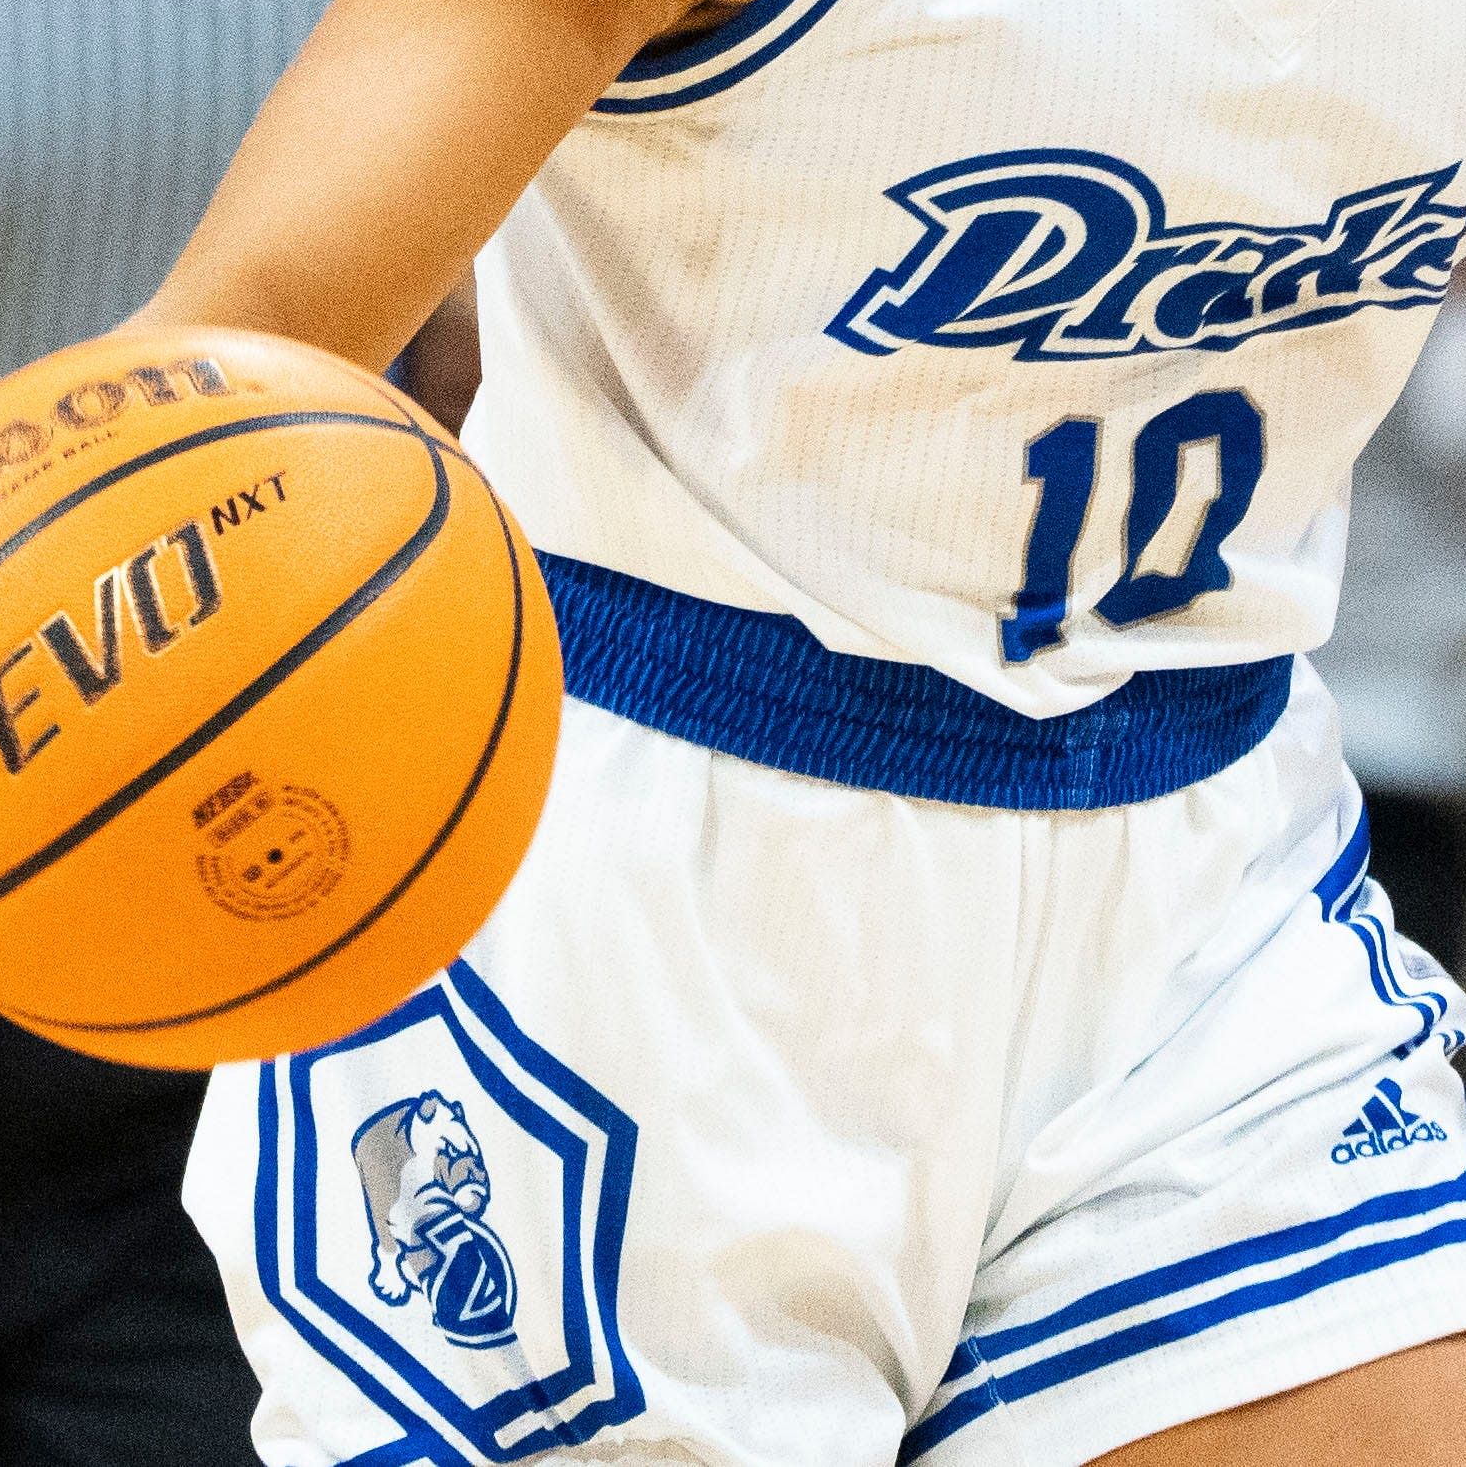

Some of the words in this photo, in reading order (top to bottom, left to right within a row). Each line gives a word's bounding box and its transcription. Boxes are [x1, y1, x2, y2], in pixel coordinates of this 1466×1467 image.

[209, 469, 287, 536] NXT
[998, 386, 1268, 668] 10
[1330, 1119, 1447, 1165] adidas
